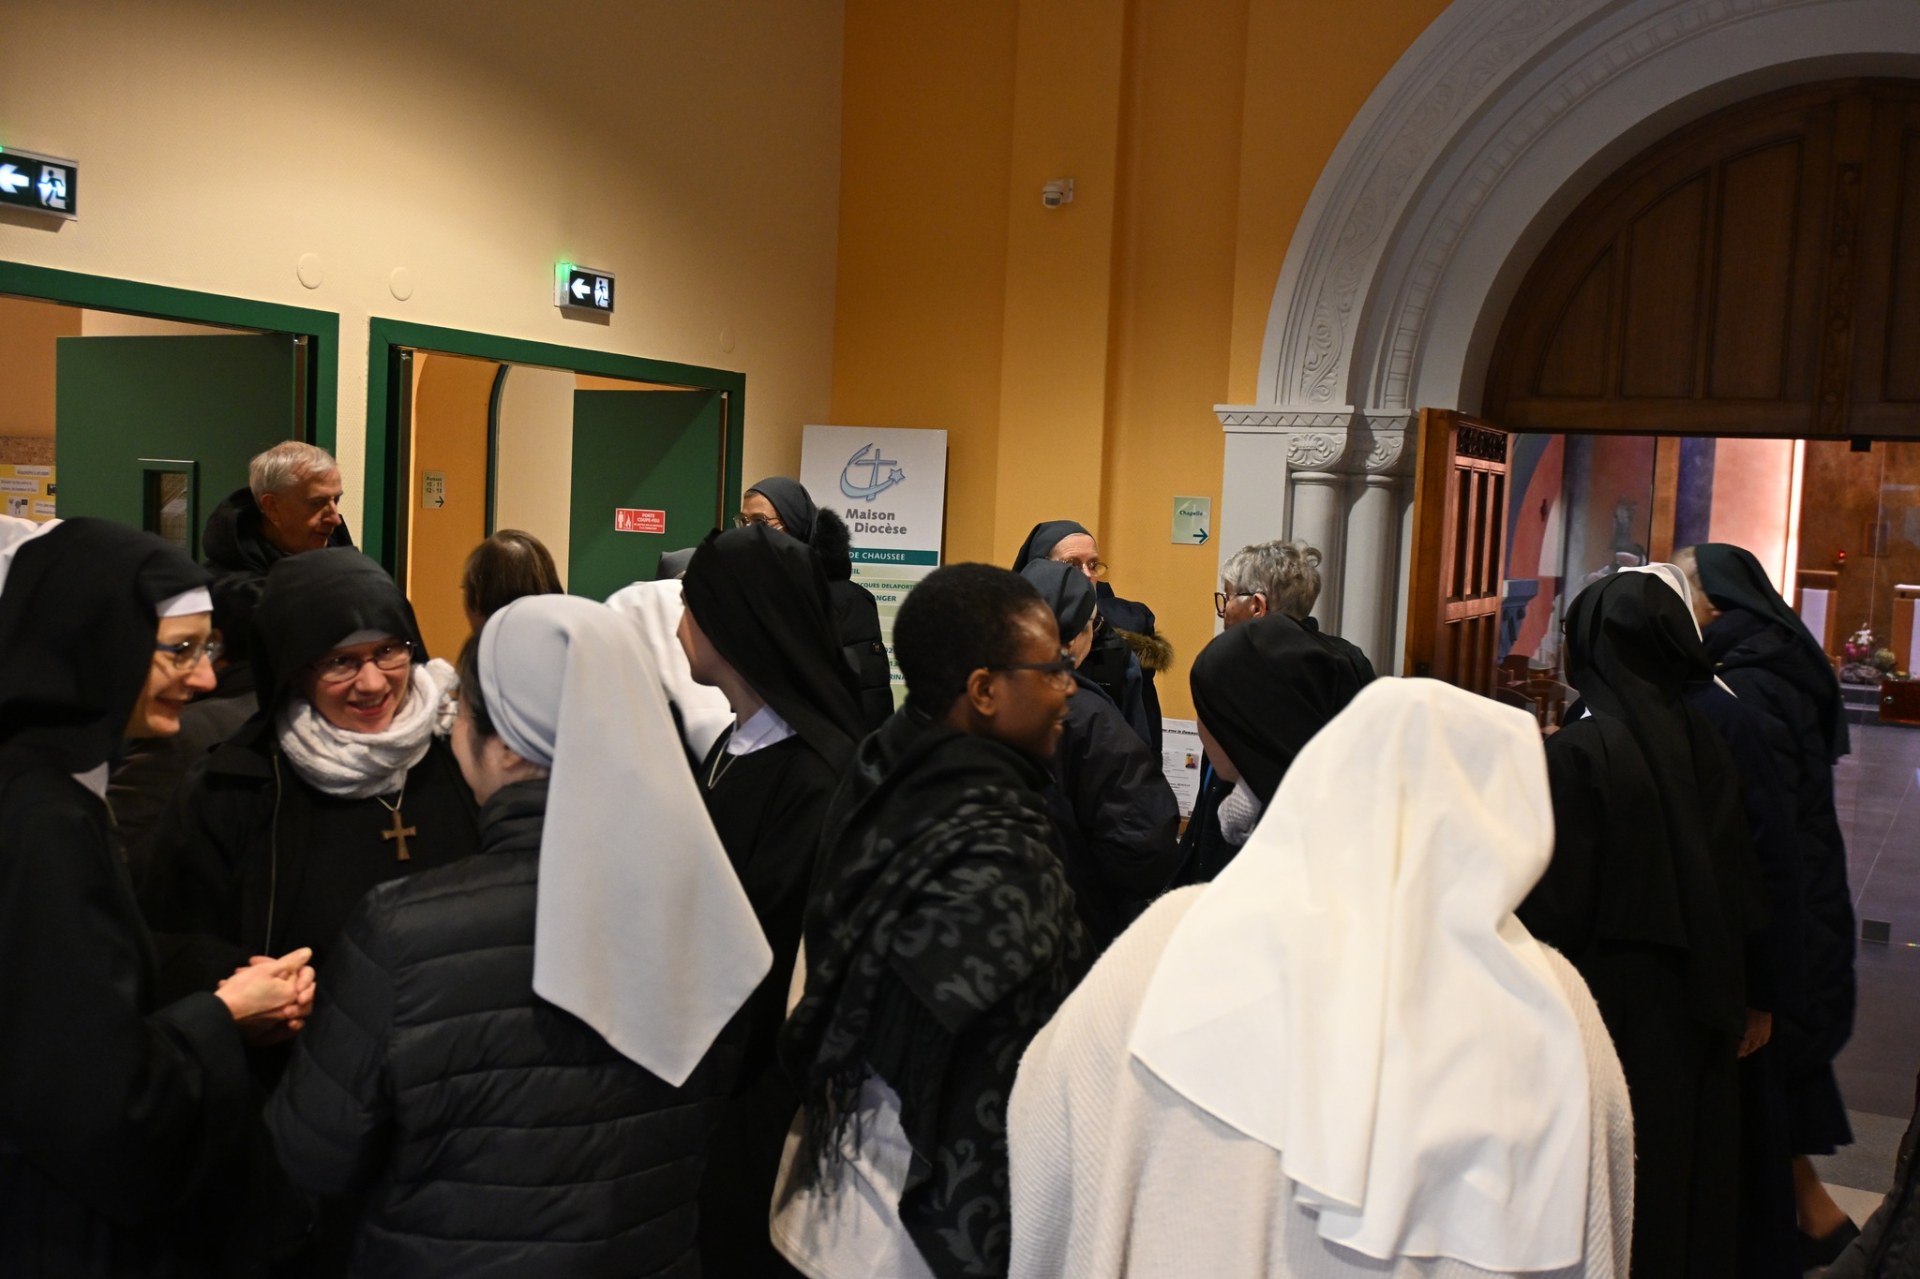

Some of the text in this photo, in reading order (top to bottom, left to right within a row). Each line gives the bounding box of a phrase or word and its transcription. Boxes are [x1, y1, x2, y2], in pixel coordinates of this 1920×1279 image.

[846, 508, 895, 520] Maison
[854, 522, 907, 534] Diocèse
[862, 552, 905, 560] CHAUSSEE
